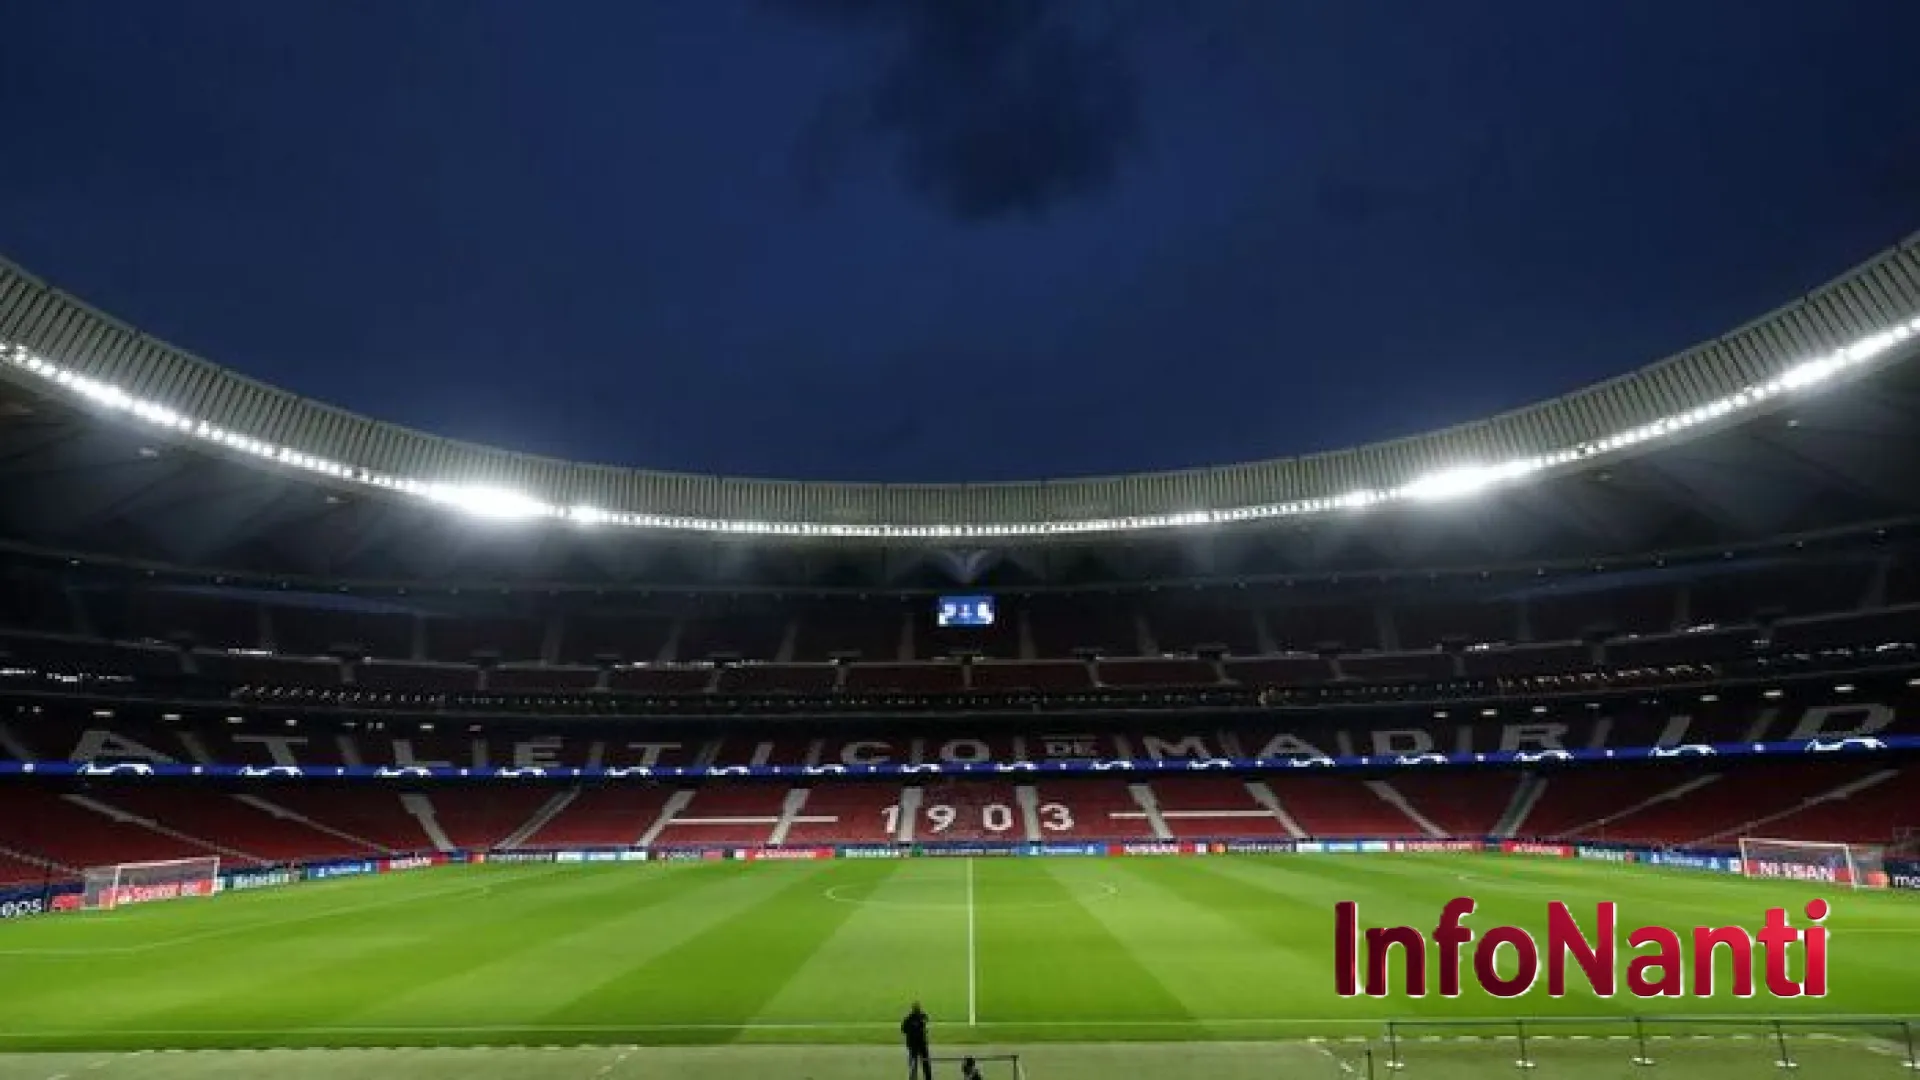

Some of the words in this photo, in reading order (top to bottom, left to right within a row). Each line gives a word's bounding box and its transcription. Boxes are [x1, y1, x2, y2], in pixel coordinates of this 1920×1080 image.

[1142, 703, 1896, 759] MADRID
[881, 803, 1075, 833] 1903
[1759, 861, 1836, 882] NISSAN
